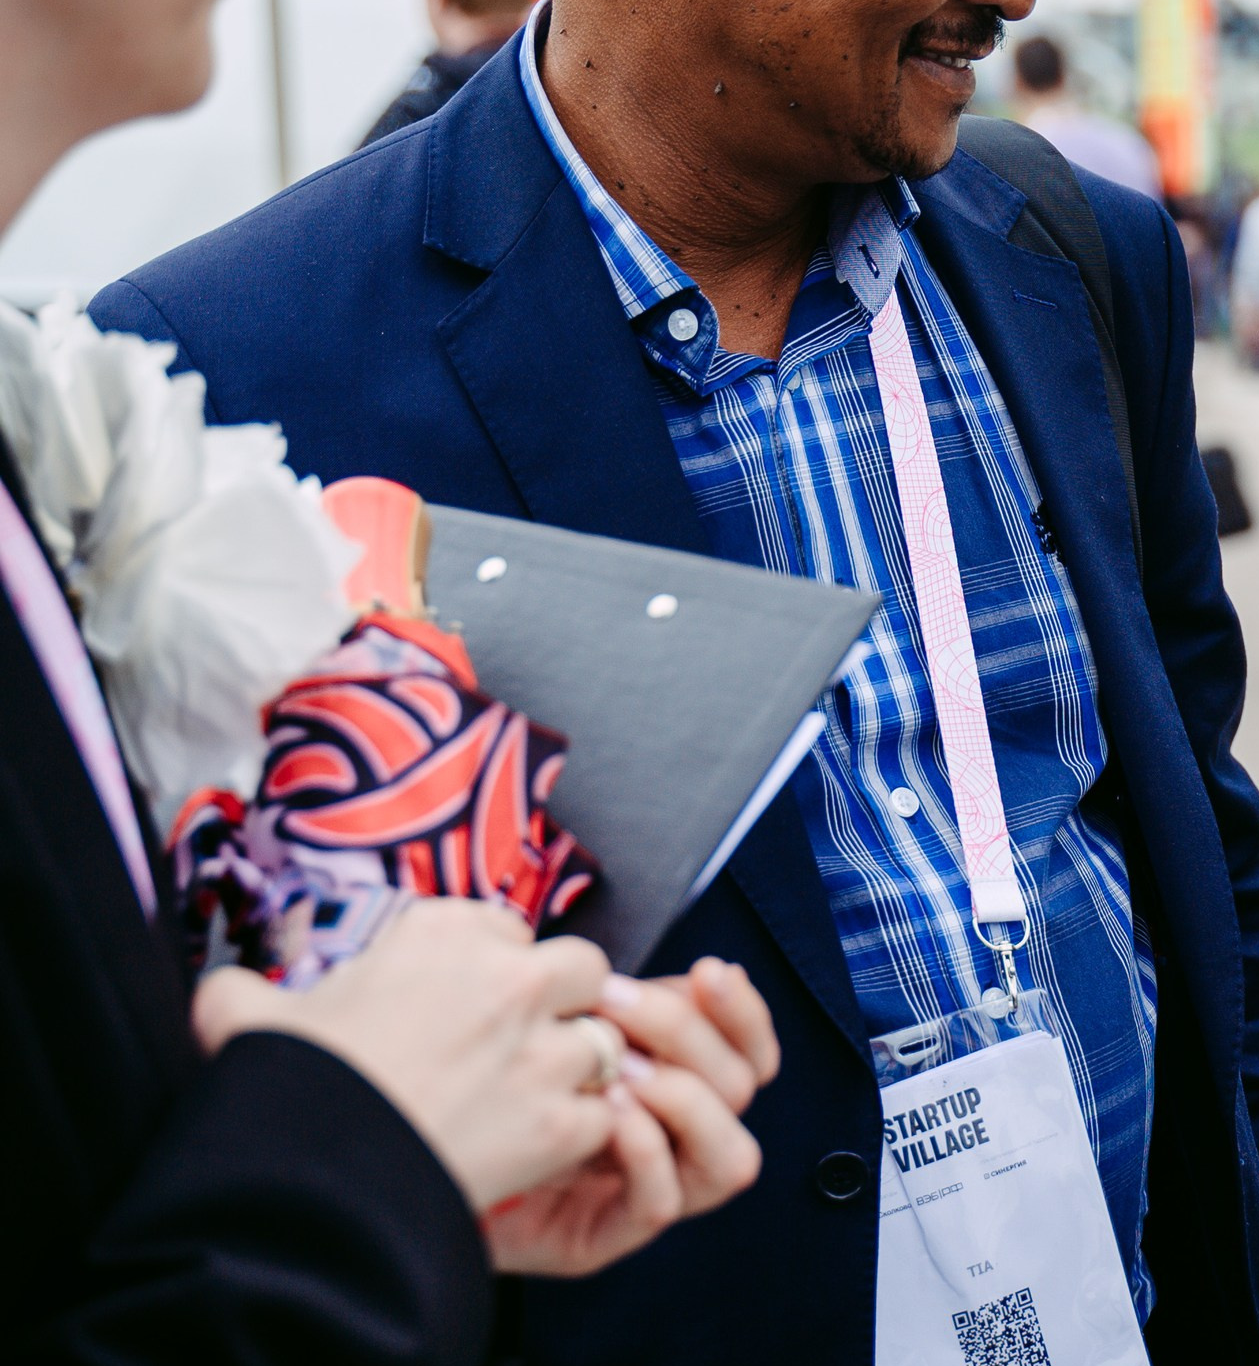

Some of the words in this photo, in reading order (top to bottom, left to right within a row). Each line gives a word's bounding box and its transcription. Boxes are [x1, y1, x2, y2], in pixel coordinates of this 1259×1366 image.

[884, 1087, 981, 1145] STARTUP
[892, 1117, 990, 1173] VILLAGE
[990, 1159, 1027, 1177] СИНЕРГИЯ
[966, 1260, 994, 1277] TIA
